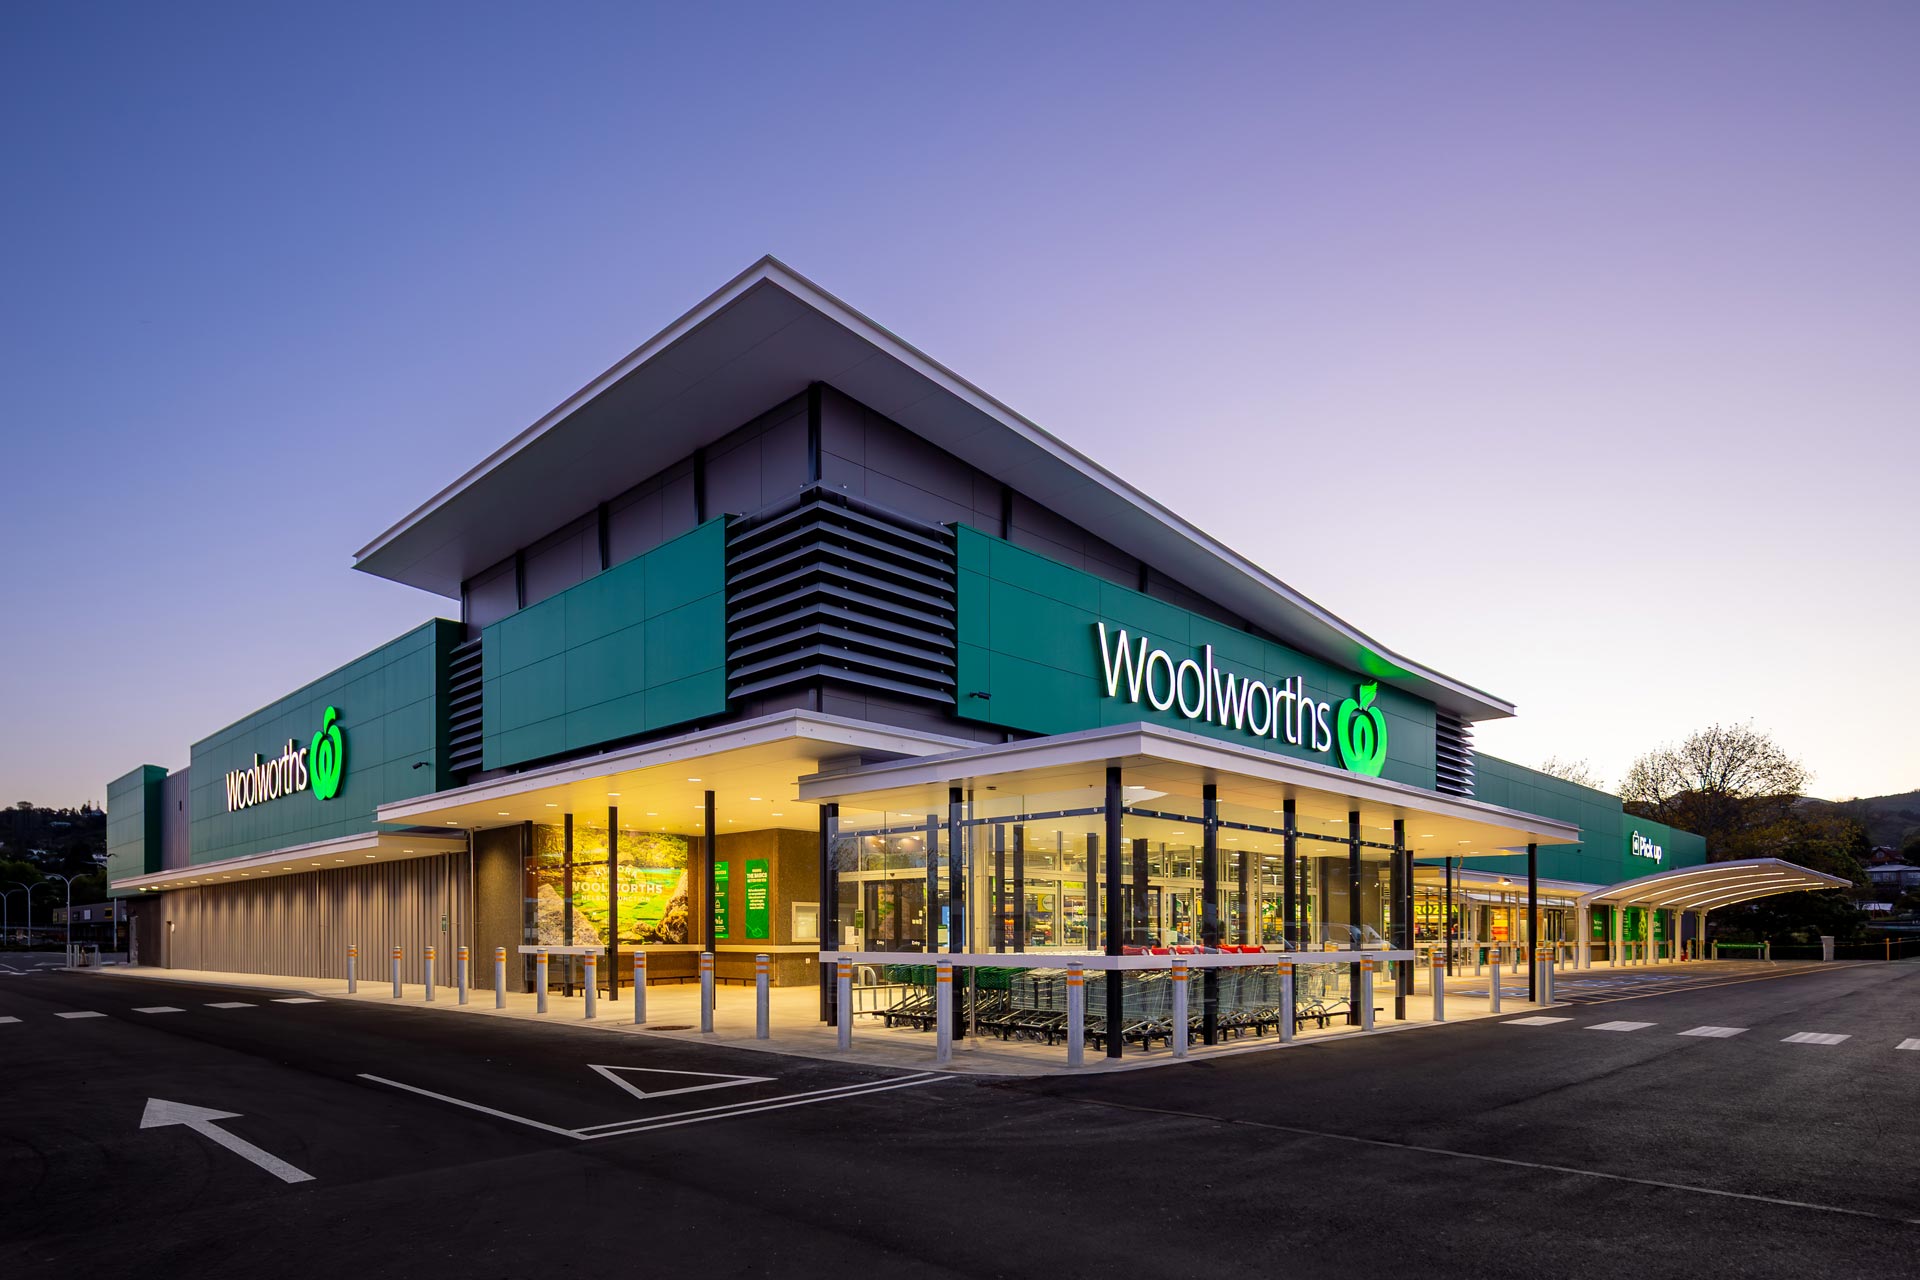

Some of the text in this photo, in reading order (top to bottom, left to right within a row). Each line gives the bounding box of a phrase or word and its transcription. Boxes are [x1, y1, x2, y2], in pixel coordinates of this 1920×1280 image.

[1098, 622, 1332, 752] Woolworths
[226, 738, 308, 813] Woolworths
[1640, 836, 1662, 865] Pick up
[572, 881, 663, 895] WOOLORTHS
[581, 894, 651, 903] NELSO UNCTION
[1414, 904, 1459, 915] ROZEN
